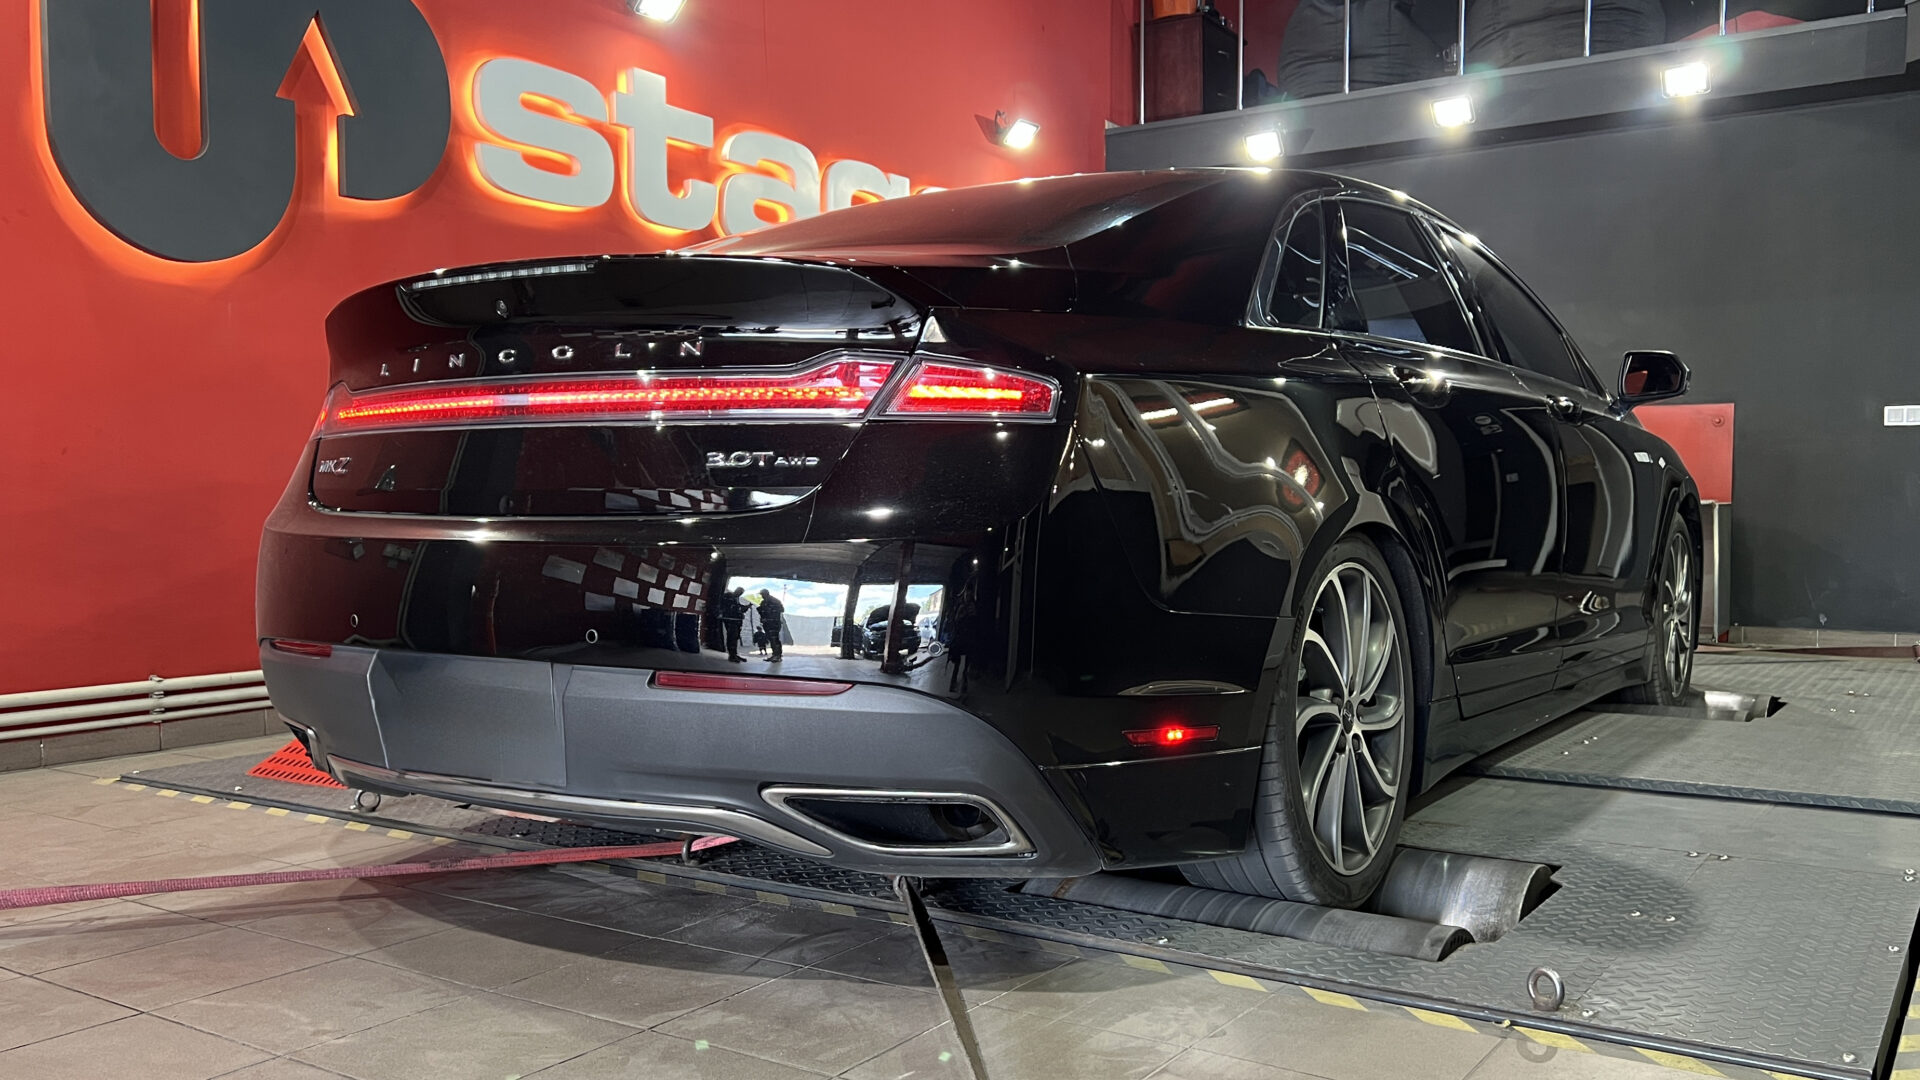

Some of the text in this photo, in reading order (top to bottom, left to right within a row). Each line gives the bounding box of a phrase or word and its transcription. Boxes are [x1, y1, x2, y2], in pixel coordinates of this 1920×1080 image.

[380, 341, 703, 376] LINCOLN
[319, 457, 352, 473] MKZ
[774, 456, 820, 466] AWD
